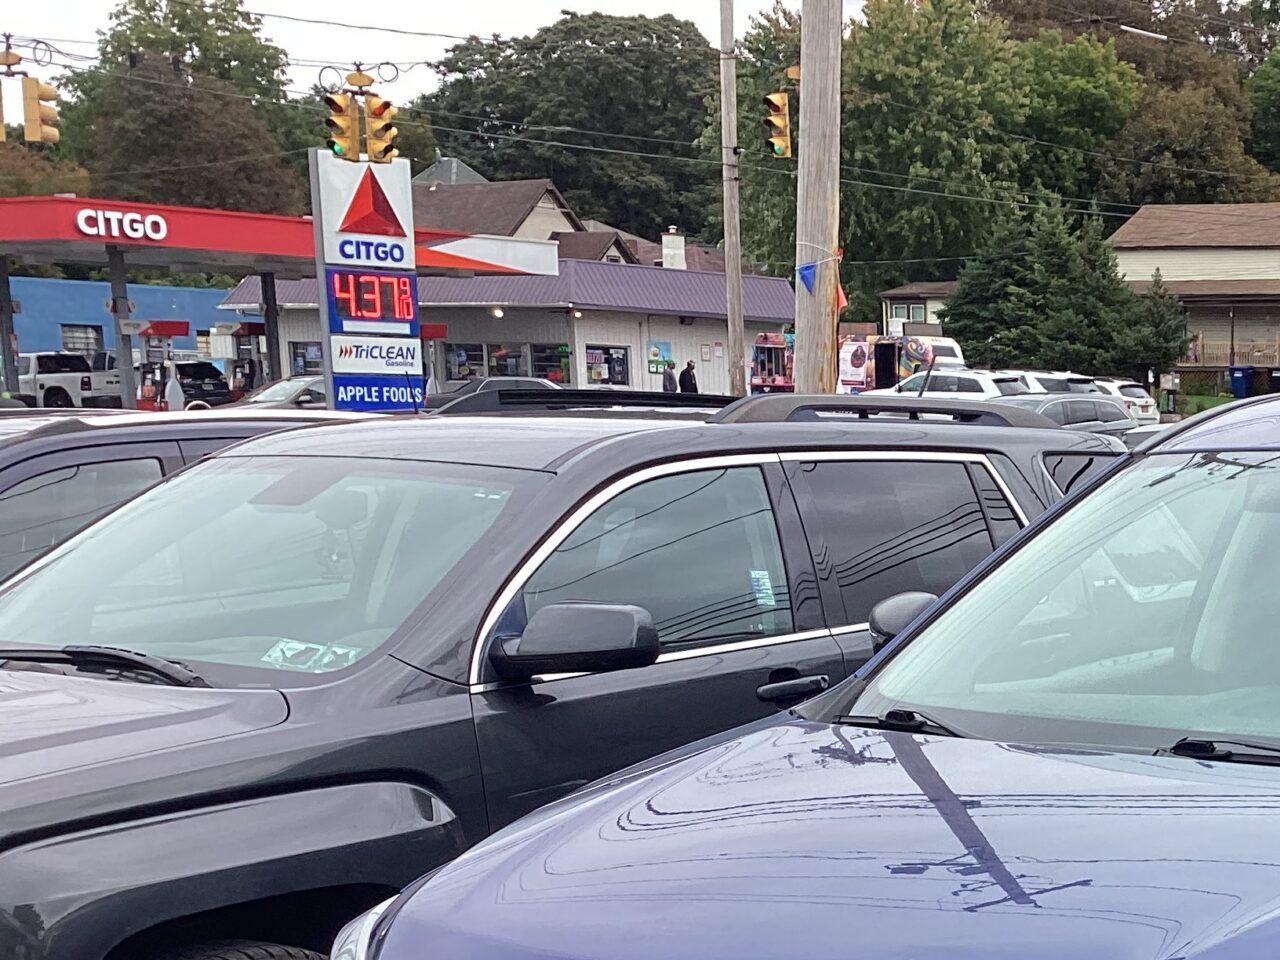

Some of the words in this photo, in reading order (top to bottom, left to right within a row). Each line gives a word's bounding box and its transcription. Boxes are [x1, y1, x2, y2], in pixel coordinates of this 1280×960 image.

[76, 208, 168, 240] CITGO
[339, 239, 405, 263] CITGO
[352, 344, 416, 360] TriCLEAN
[385, 359, 414, 367] Gasoline
[338, 386, 380, 402] APPLE
